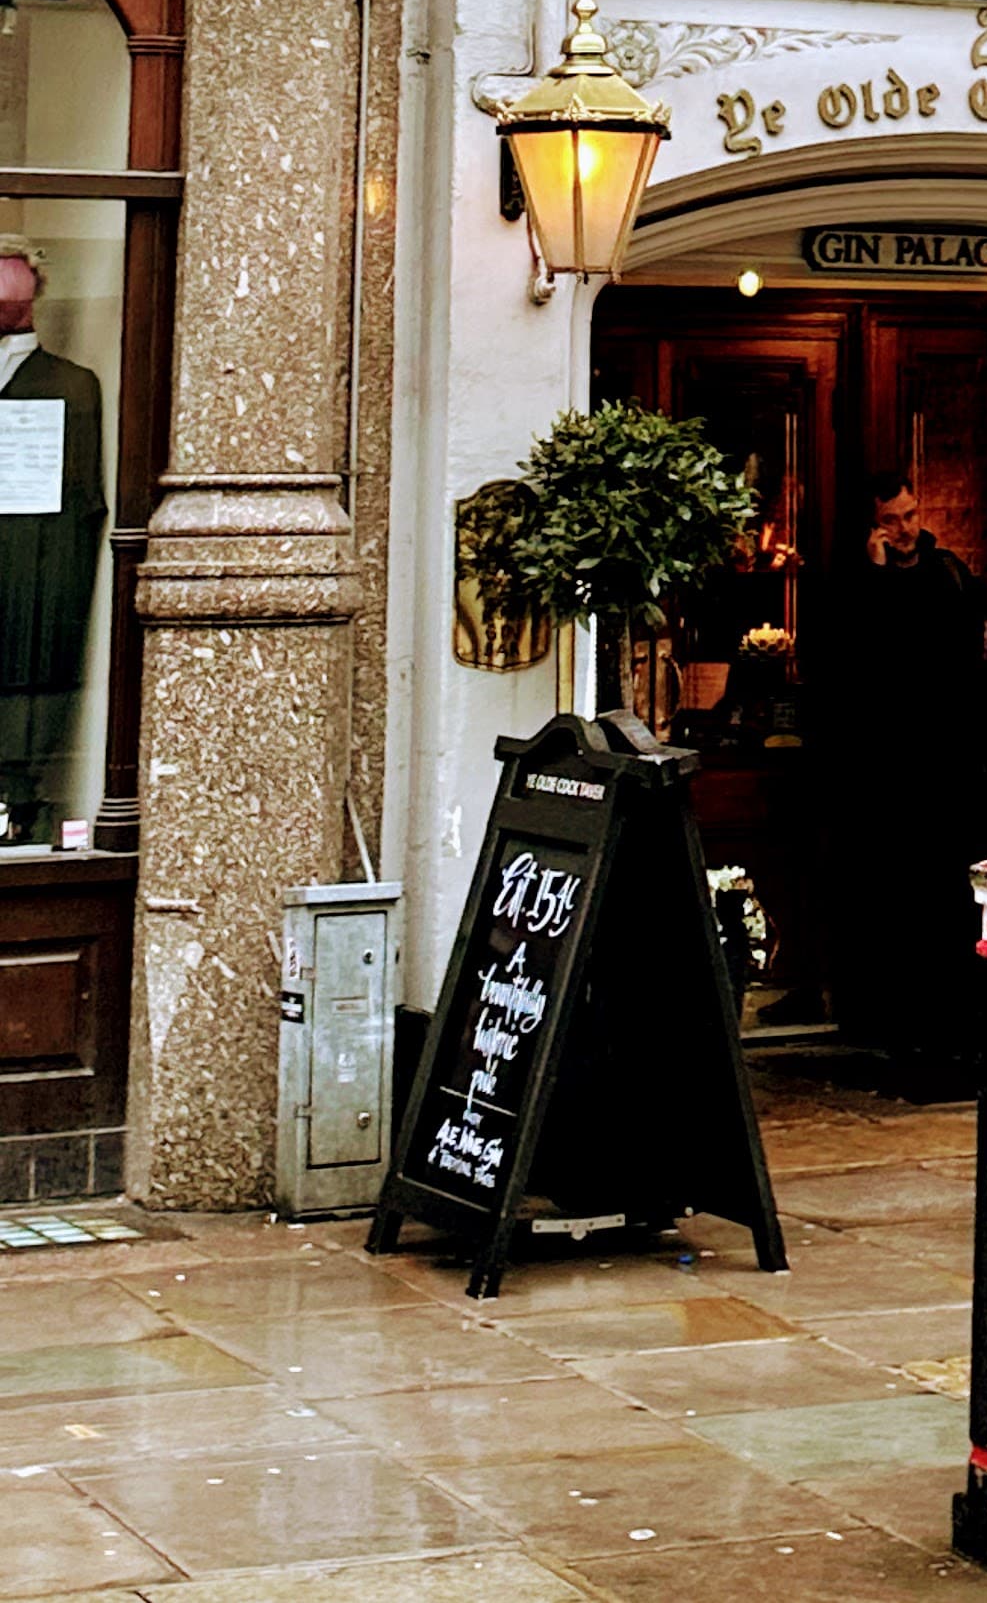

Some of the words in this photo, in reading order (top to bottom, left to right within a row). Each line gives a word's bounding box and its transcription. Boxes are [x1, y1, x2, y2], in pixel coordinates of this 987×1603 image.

[716, 89, 787, 156] Ye
[817, 67, 941, 129] Olde
[818, 233, 882, 263] GIN
[505, 941, 526, 974] A
